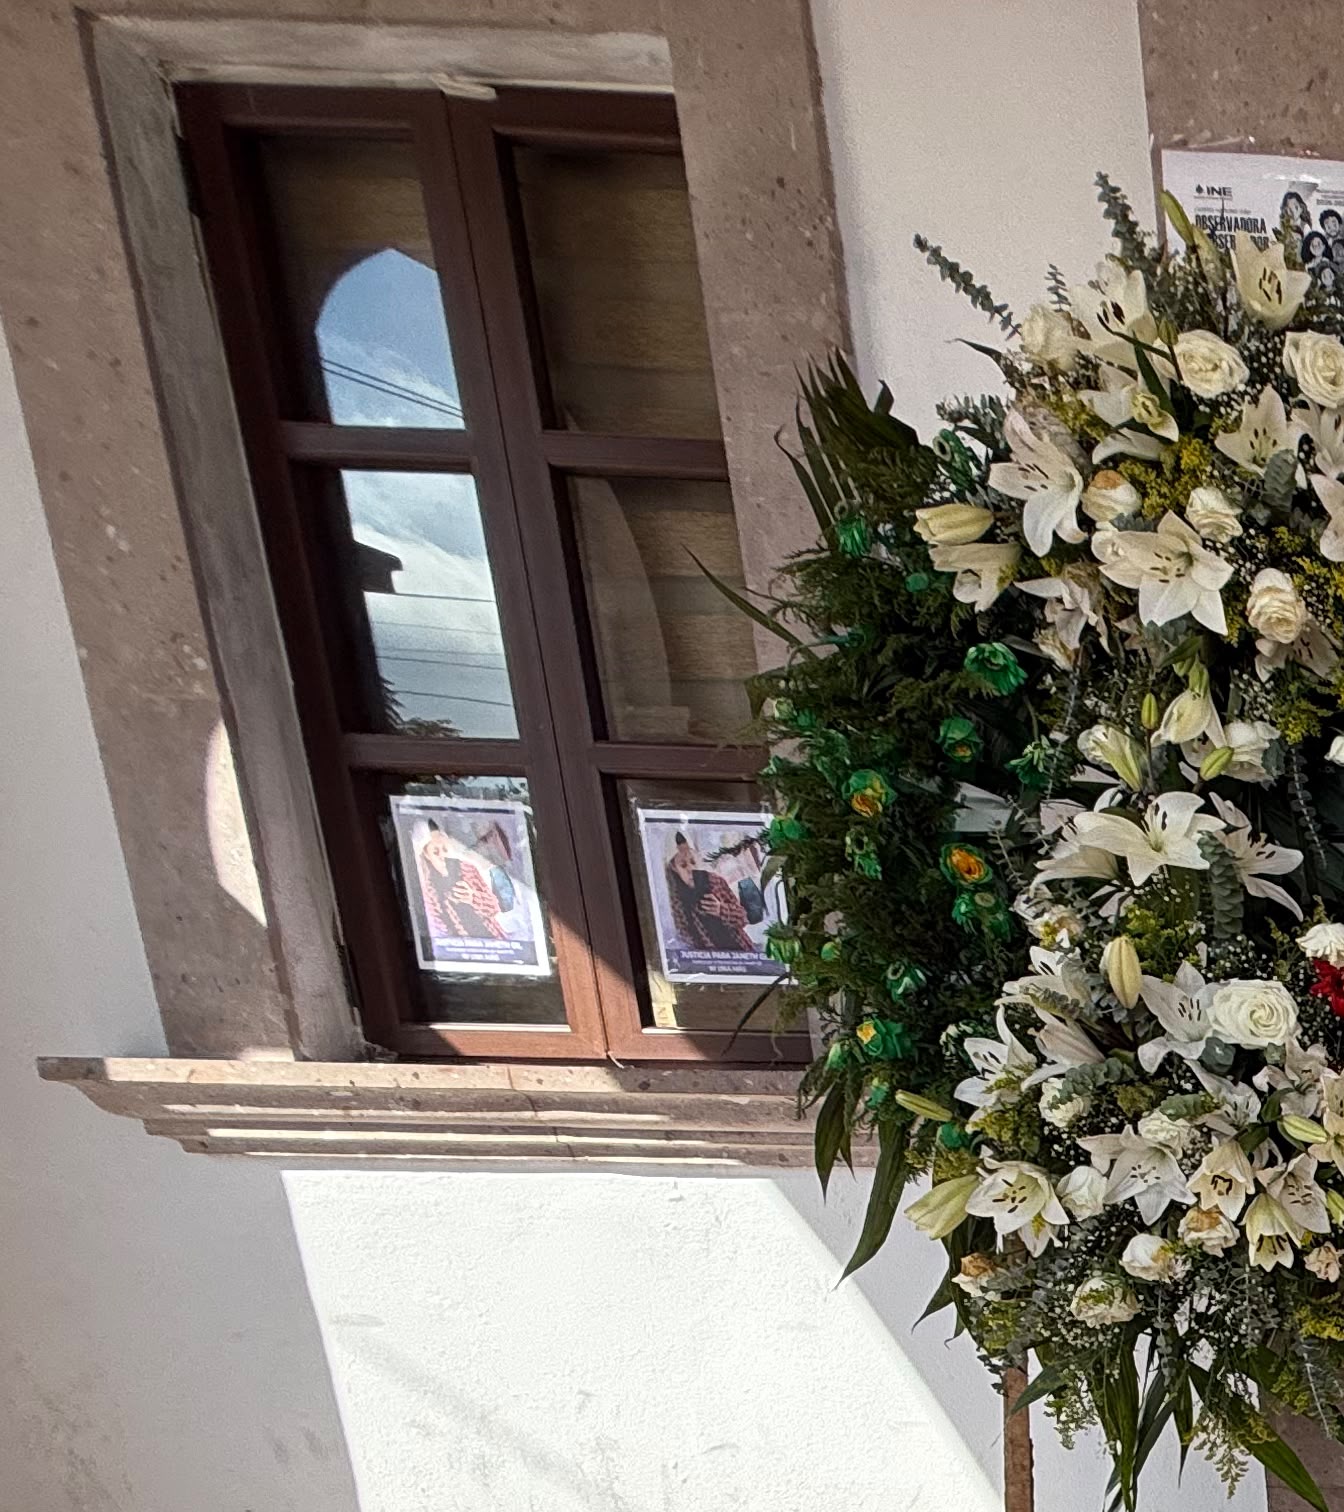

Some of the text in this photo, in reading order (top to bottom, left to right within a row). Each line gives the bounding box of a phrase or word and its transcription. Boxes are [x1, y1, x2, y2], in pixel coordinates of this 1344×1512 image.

[1206, 186, 1232, 196] INE
[1195, 214, 1267, 234] OBSERVADORA
[681, 951, 711, 959] JUSTICIA
[712, 951, 731, 959] PARA
[732, 952, 758, 960] JANETH
